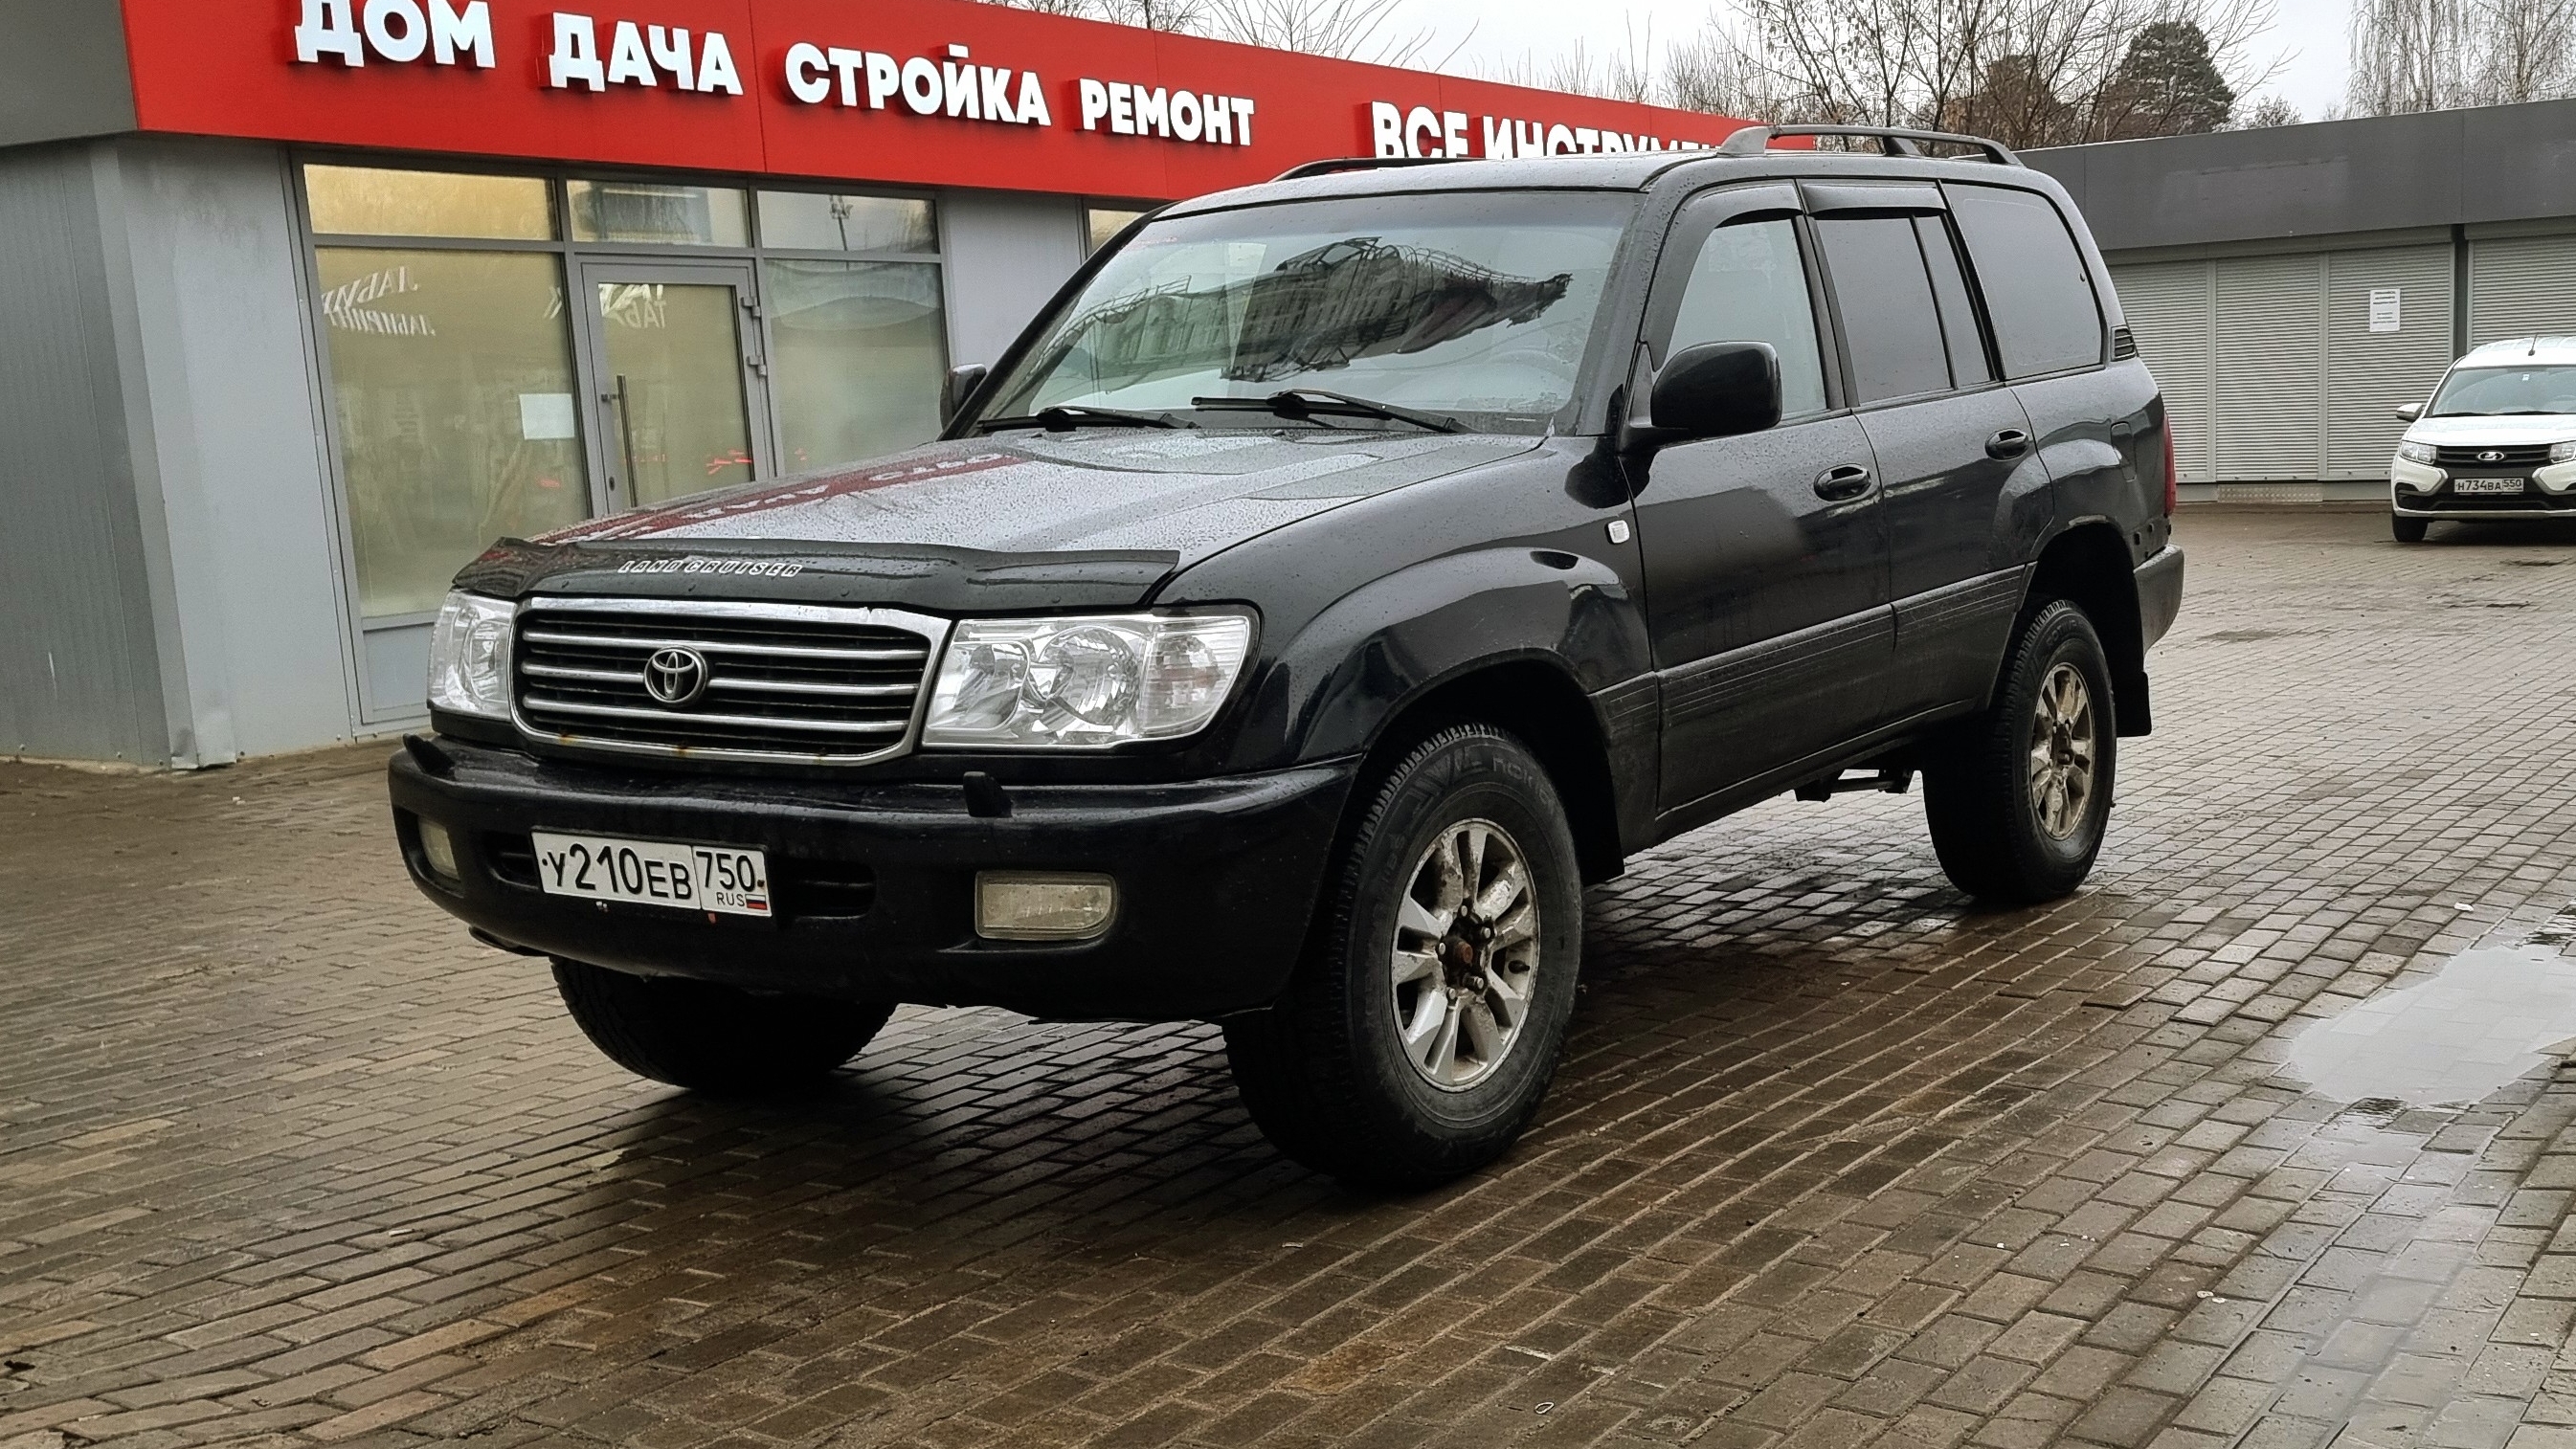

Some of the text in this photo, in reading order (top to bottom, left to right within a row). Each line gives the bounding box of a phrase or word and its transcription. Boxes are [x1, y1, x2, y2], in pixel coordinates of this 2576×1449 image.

[294, 0, 1254, 146] ДОМ ДАЧА СТРОЙКА РЕМОНТ
[1372, 101, 1469, 158] ВСЕ
[617, 560, 802, 577] LAND CRUISER
[547, 843, 755, 900] У210ЕВ 750
[716, 891, 745, 907] RUS
